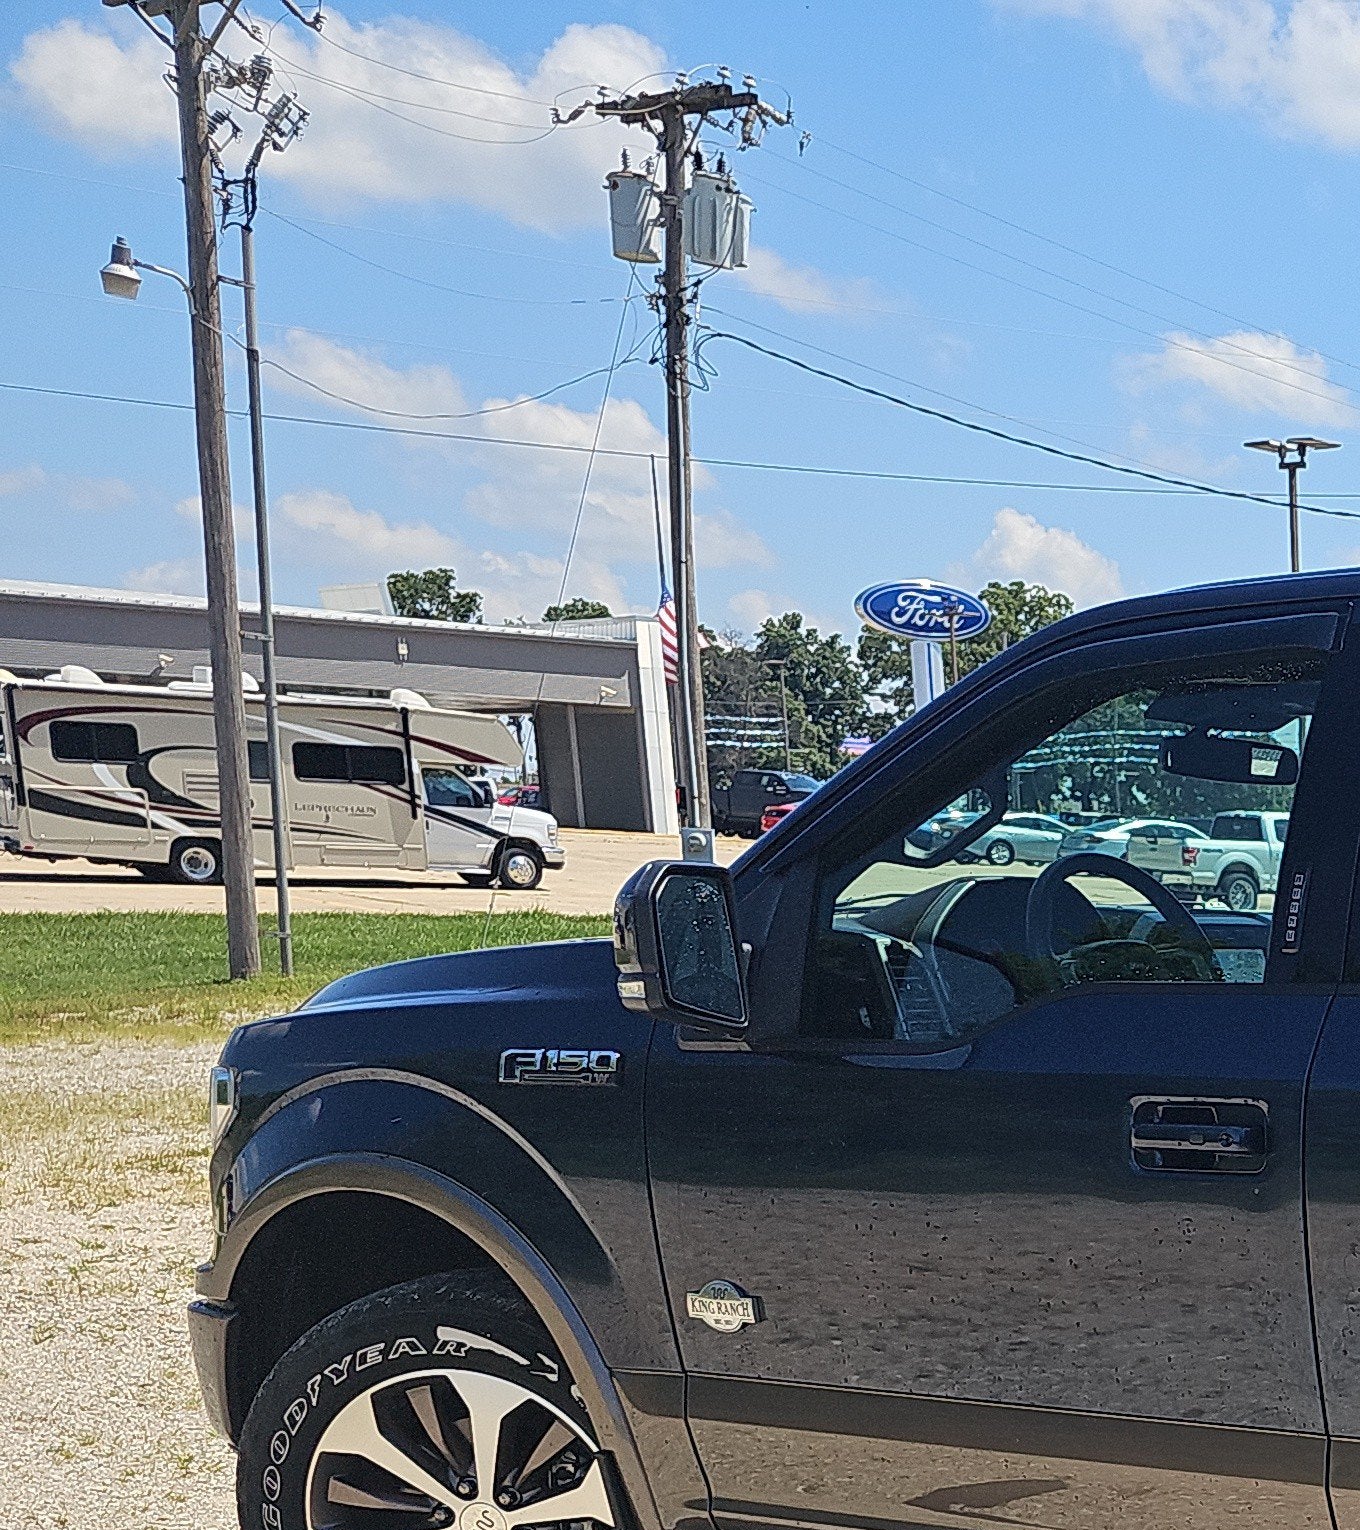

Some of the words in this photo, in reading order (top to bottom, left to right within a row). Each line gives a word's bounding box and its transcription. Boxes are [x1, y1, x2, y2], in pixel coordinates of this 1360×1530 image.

[891, 591, 965, 629] Ford
[691, 1297, 715, 1315] KING
[716, 1301, 751, 1317] RANCH
